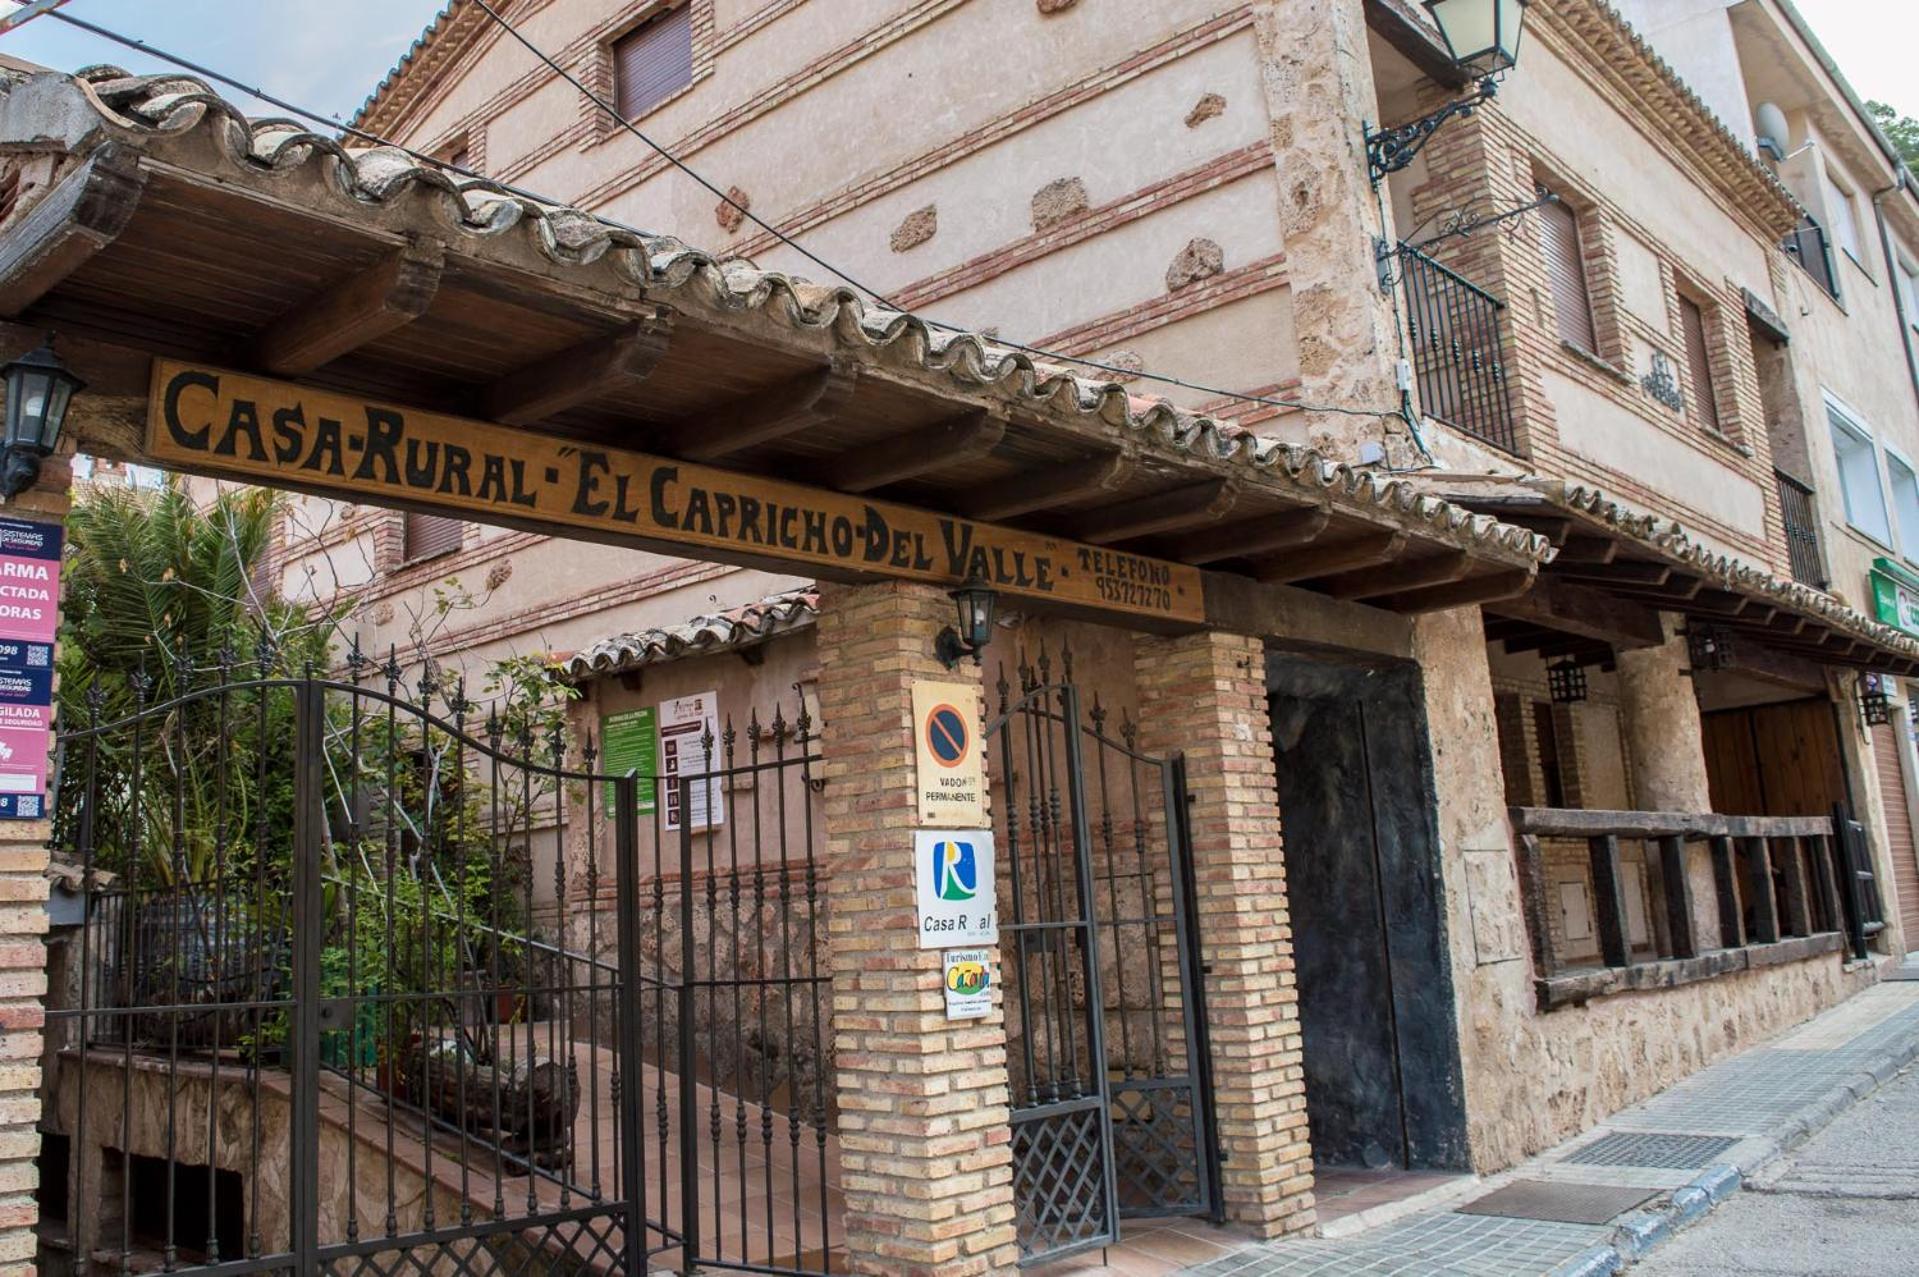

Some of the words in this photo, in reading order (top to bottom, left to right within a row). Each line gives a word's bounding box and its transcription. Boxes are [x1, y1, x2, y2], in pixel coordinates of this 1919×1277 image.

[0, 561, 49, 581] RMA
[1077, 546, 1171, 587] TELEFONO
[923, 915, 955, 932] Casa
[957, 912, 991, 931] Ral
